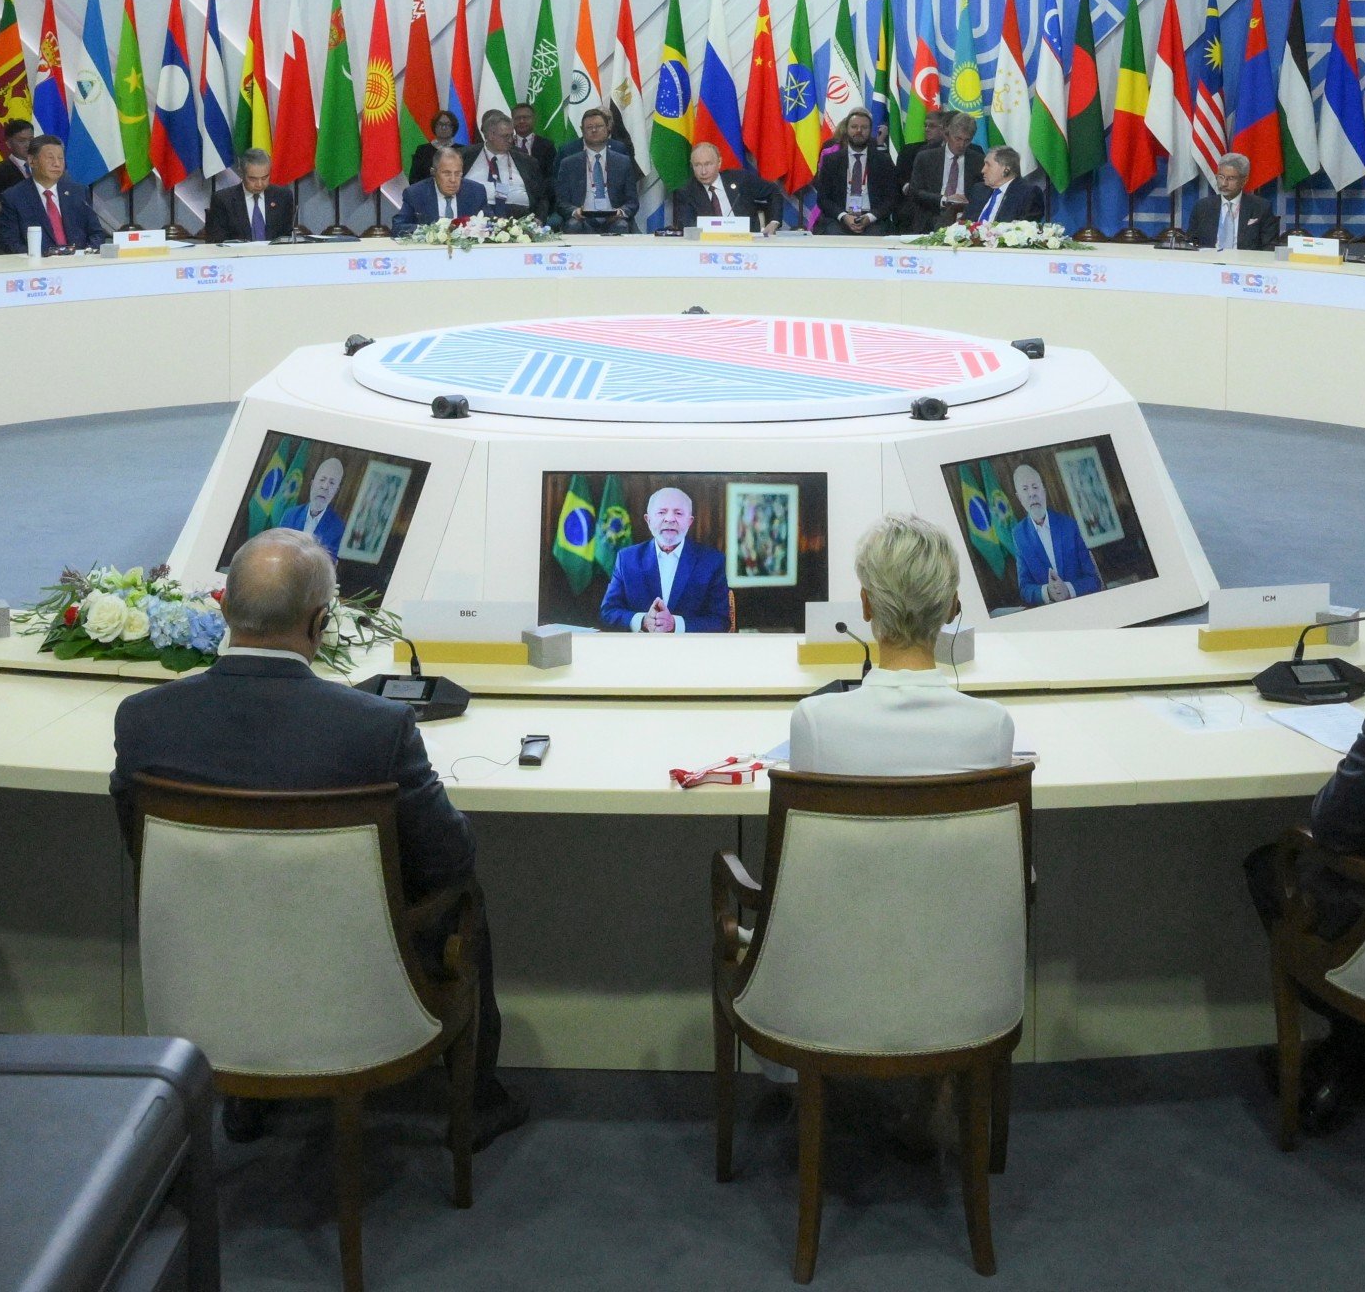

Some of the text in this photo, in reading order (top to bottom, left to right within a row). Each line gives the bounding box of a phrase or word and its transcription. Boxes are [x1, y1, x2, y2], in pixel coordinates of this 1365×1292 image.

[568, 261, 583, 270] 24
[743, 262, 758, 271] 24
[392, 266, 407, 275] 24
[919, 266, 933, 275] 24
[219, 274, 234, 283] 24
[1093, 273, 1107, 283] 24
[48, 286, 63, 296] 24
[1264, 285, 1278, 295] 24
